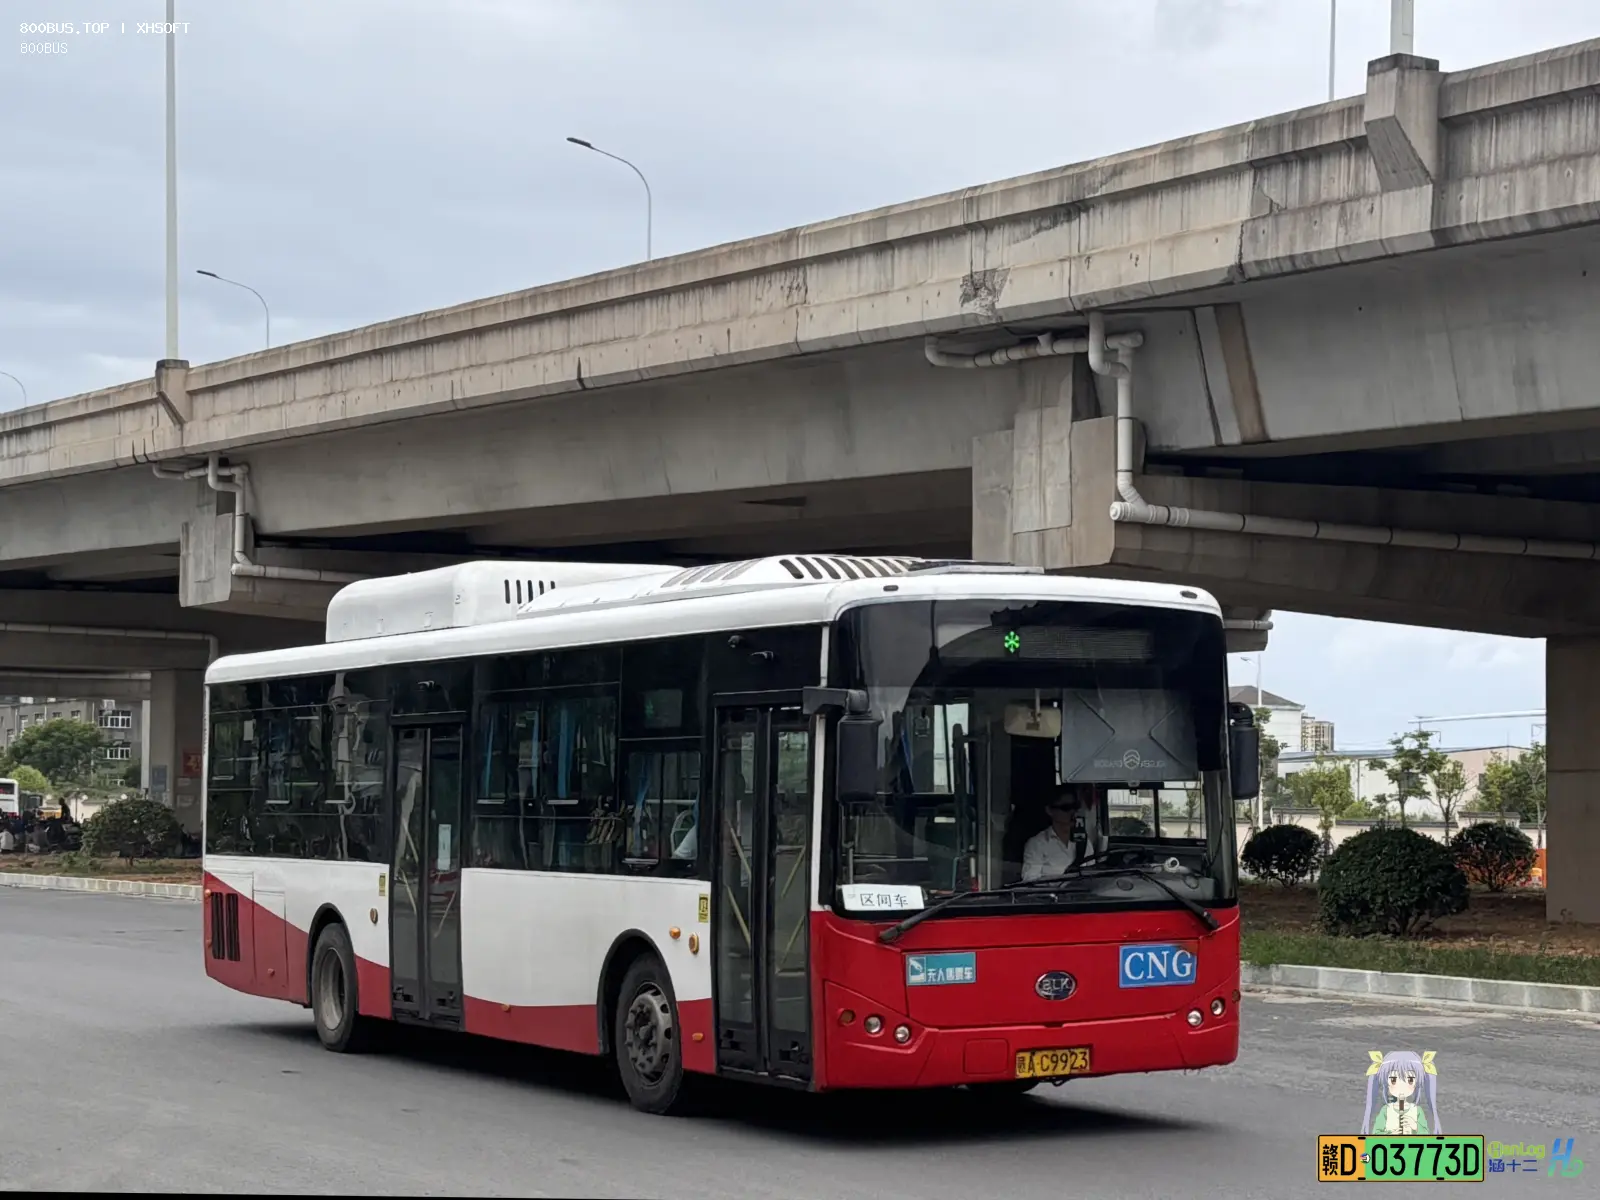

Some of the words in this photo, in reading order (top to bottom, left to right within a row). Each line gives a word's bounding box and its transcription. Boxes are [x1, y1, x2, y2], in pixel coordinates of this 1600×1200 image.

[860, 893, 909, 908] 区间车
[1126, 950, 1193, 980] CNG
